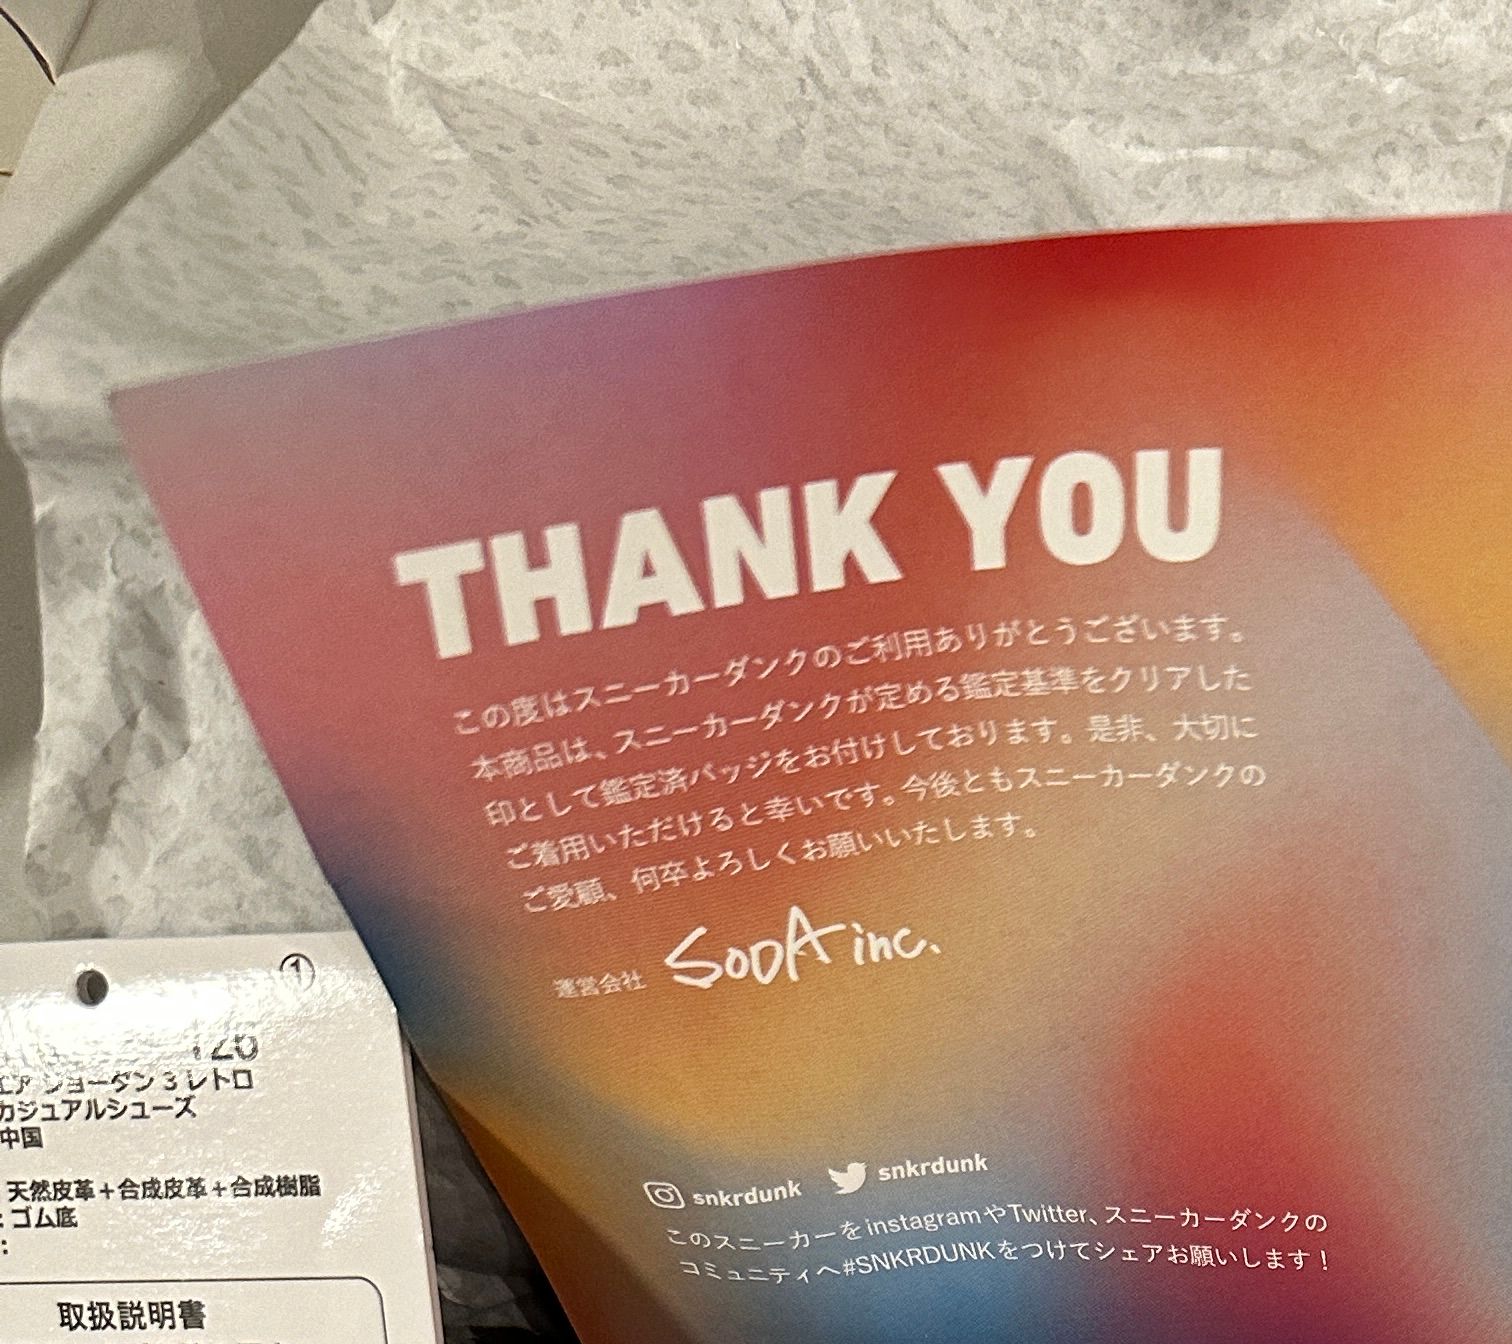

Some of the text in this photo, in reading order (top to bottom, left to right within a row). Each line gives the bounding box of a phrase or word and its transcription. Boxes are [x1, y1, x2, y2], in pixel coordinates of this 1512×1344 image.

[392, 446, 1224, 661] THANK YOU
[453, 613, 1245, 736] この度はスニーカーダンクのご利用ありがとうございます。
[850, 921, 942, 967] inc.
[186, 1067, 254, 1091] レトロ
[0, 1126, 44, 1150] 中国
[878, 1153, 989, 1182] snkrdunk
[692, 1180, 803, 1208] snkrdunk
[56, 1299, 207, 1331] 取扱説明書
